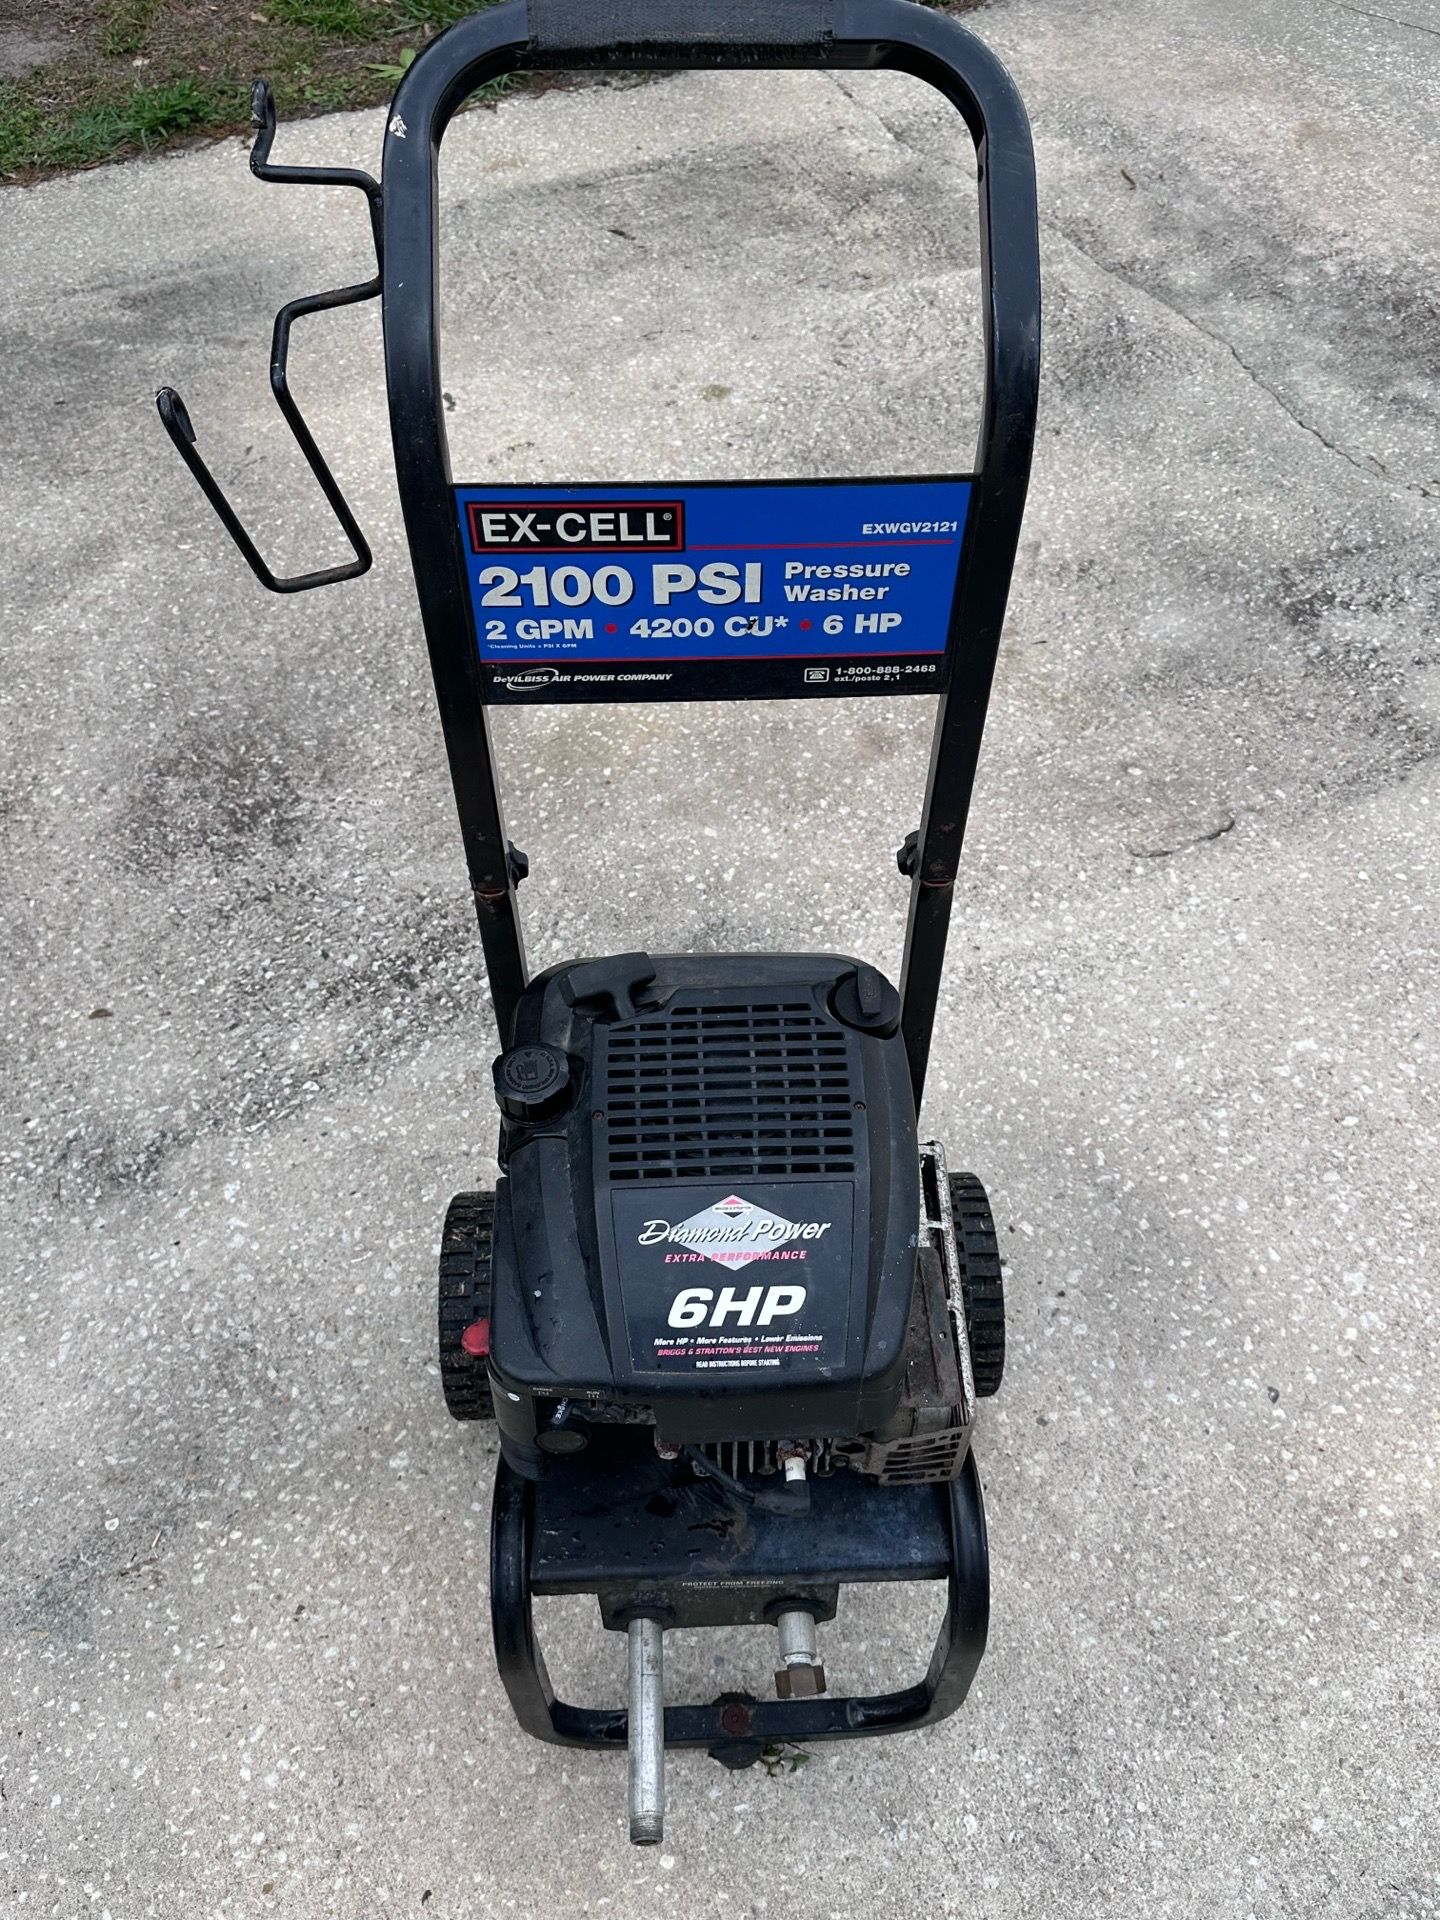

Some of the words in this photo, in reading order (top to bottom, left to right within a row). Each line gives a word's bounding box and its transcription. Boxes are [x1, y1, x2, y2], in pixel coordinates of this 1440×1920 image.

[862, 521, 958, 535] EXWGV2121
[784, 561, 911, 580] Pressure
[478, 564, 634, 607] 2100
[652, 562, 762, 605] PSI
[784, 584, 889, 602] Washer
[485, 619, 507, 640] 2
[516, 618, 594, 640] GPM
[629, 617, 715, 638] 4200
[823, 614, 844, 635] 6
[854, 613, 902, 634] HP
[573, 674, 616, 682] POWER
[617, 673, 673, 681] COMPANY
[836, 664, 936, 675] 1-800-888-2468
[638, 1219, 752, 1245] Diamond
[750, 1219, 832, 1242] Power
[664, 1253, 705, 1263] EXTRA
[711, 1250, 807, 1262] PERFORMANCE
[667, 1285, 807, 1328] 6HP
[653, 1338, 674, 1346] More
[676, 1337, 689, 1345] HP
[718, 1336, 752, 1344] Features
[785, 1334, 823, 1342] Emissions
[657, 1348, 686, 1356] BRIGGS
[695, 1347, 741, 1355] STRATTON'S
[743, 1346, 763, 1354] BEST
[764, 1345, 783, 1353] NEW
[785, 1344, 819, 1352] ENGINES
